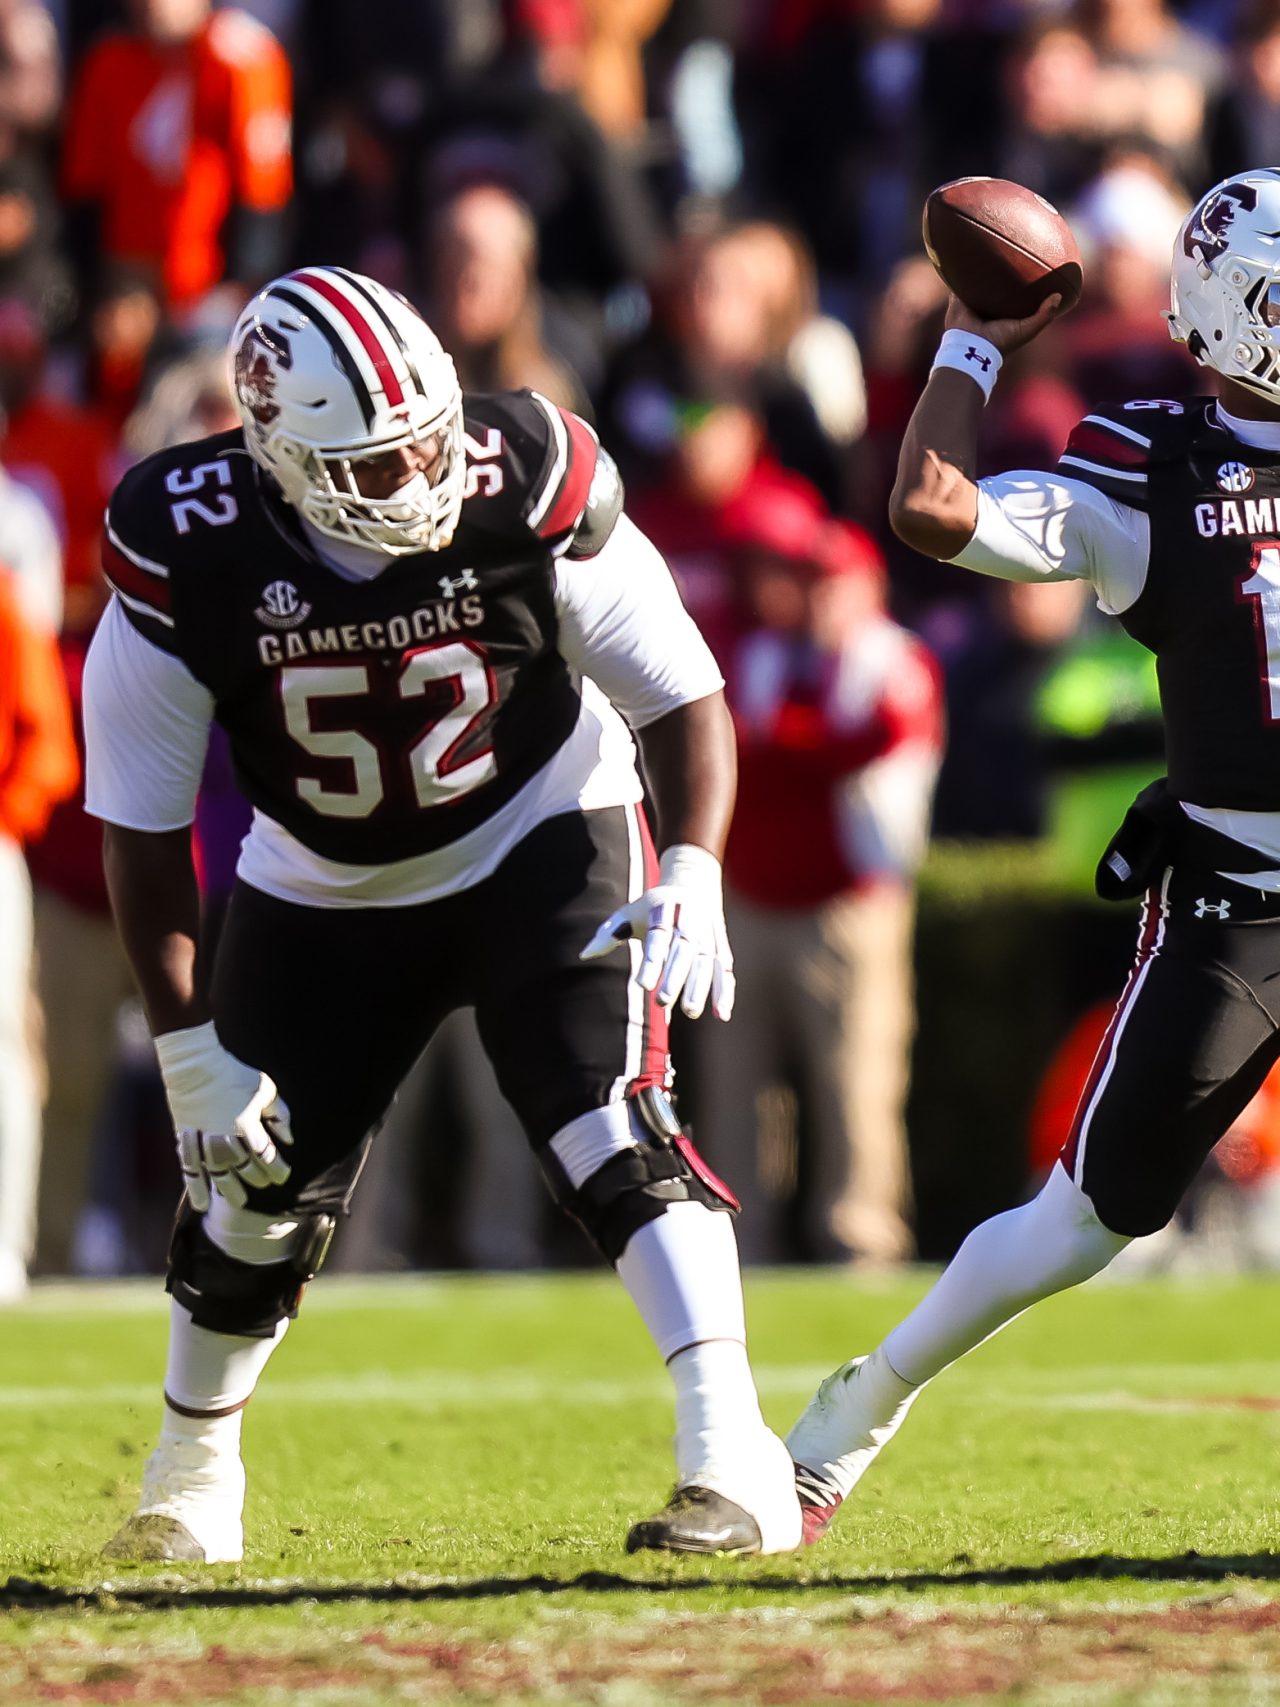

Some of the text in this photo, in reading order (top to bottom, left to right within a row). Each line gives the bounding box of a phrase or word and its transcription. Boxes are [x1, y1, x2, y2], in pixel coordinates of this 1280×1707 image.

[164, 459, 239, 535] 52
[1217, 461, 1252, 492] SEC
[257, 594, 485, 666] GAMECOCKS
[261, 579, 300, 617] SEC
[278, 640, 499, 819] 52
